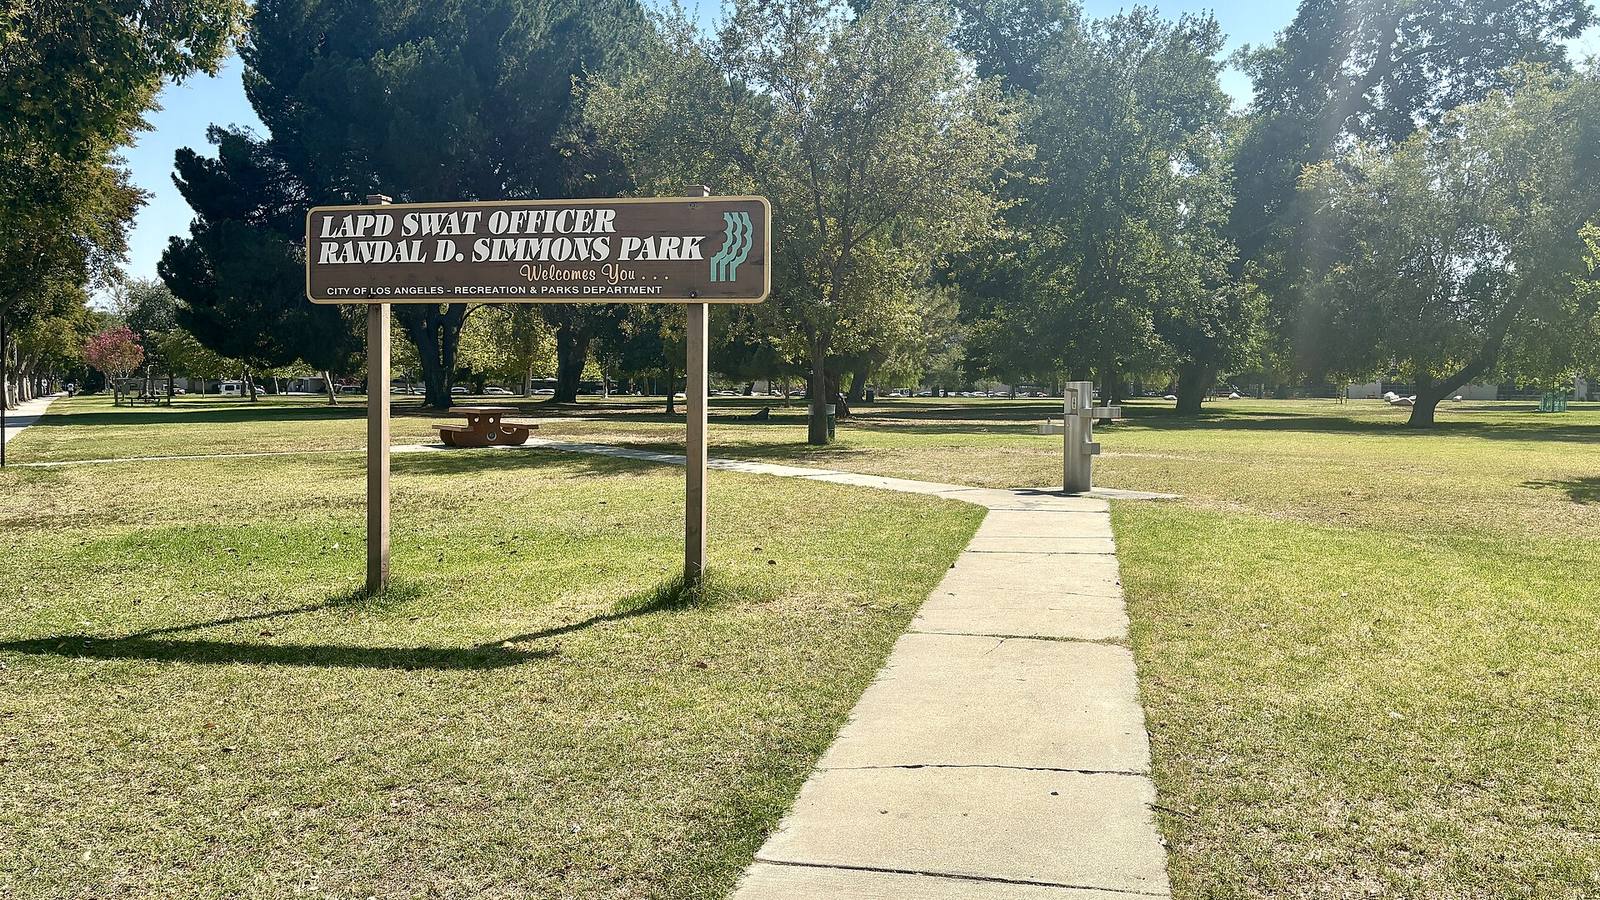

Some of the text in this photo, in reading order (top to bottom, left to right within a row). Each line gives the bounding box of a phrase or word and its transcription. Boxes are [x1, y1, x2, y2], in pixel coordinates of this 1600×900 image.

[319, 208, 617, 238] LAPD SWAT OFFICER
[318, 235, 706, 264] RANDAL D. SIMMONS PARK
[519, 264, 596, 282] Welcomes
[327, 287, 351, 296] CITY
[353, 286, 368, 295] OF
[370, 286, 391, 295] LOS
[394, 286, 444, 295] ANGELES
[454, 285, 527, 295] RECREATION
[529, 285, 538, 294] &
[541, 285, 579, 294] PARKS
[583, 285, 663, 294] DEPARTMENT
